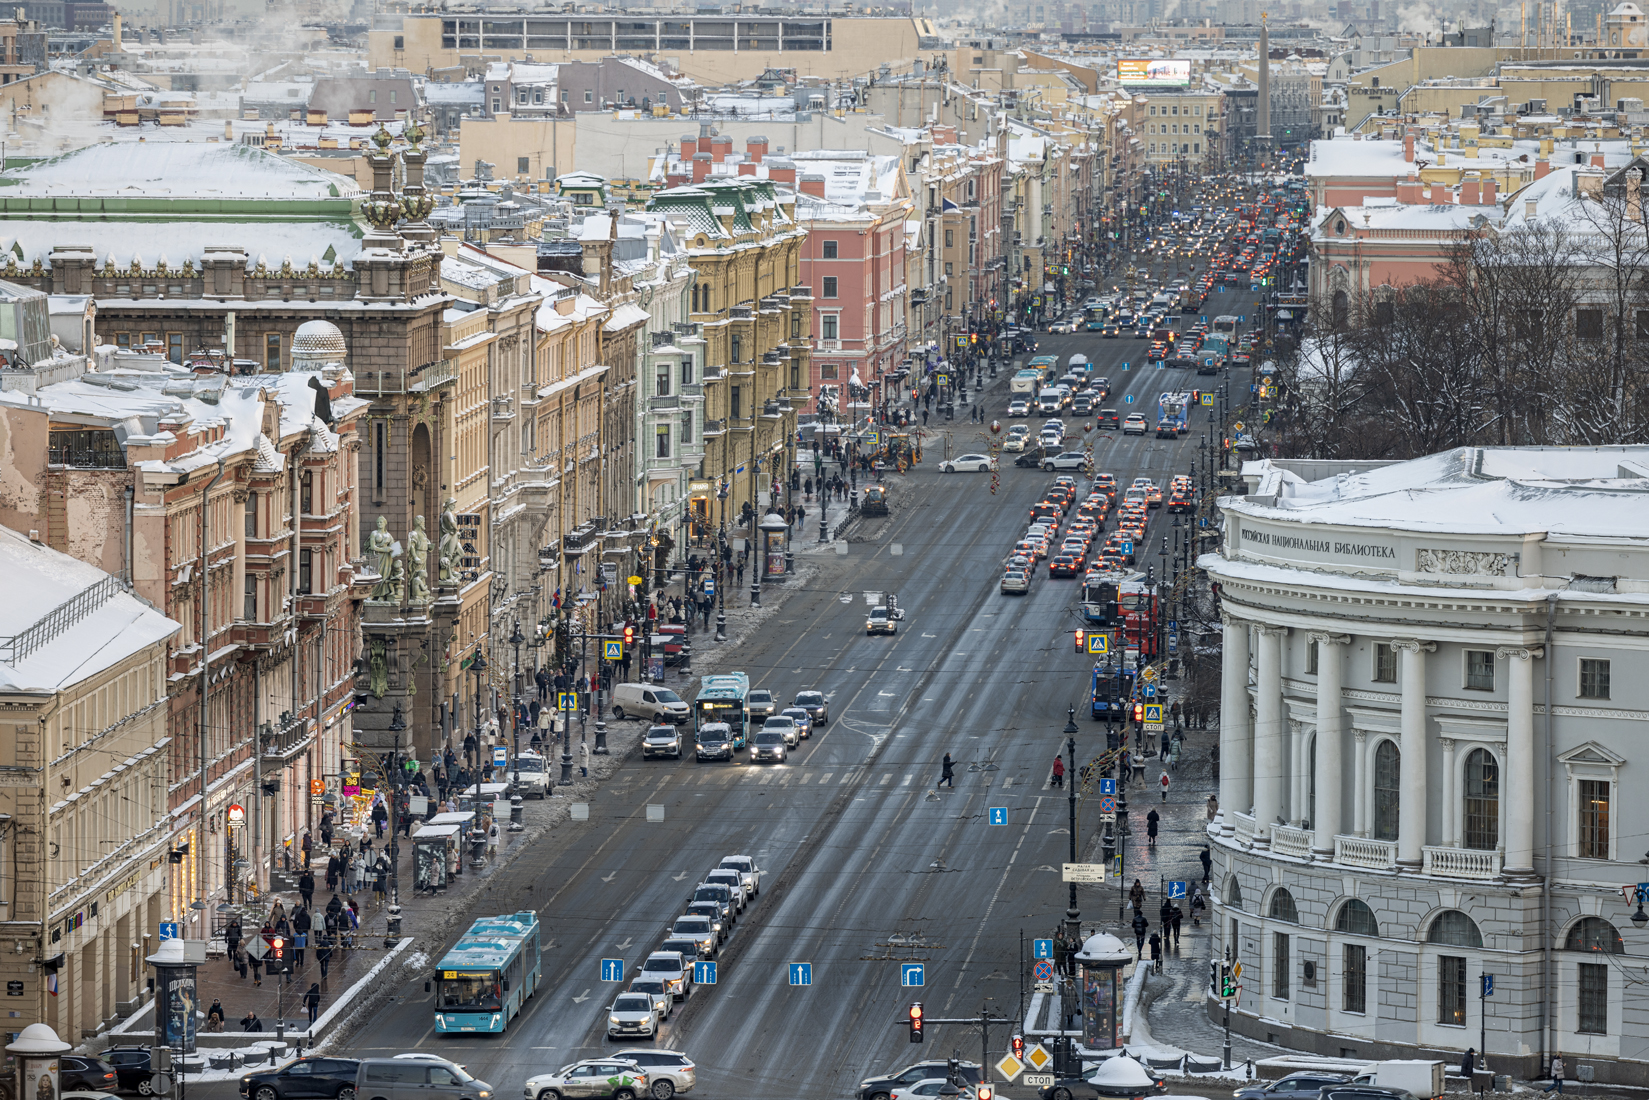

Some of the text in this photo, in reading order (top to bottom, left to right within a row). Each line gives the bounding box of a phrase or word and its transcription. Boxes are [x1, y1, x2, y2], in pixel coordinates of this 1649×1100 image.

[1351, 88, 1399, 96] CORINTHIA
[1241, 528, 1396, 559] РОССИЙСКАЯ НАЦИОНАЛЬНАЯ БИБЛИОТЕКА
[1027, 1076, 1051, 1084] СТОП
